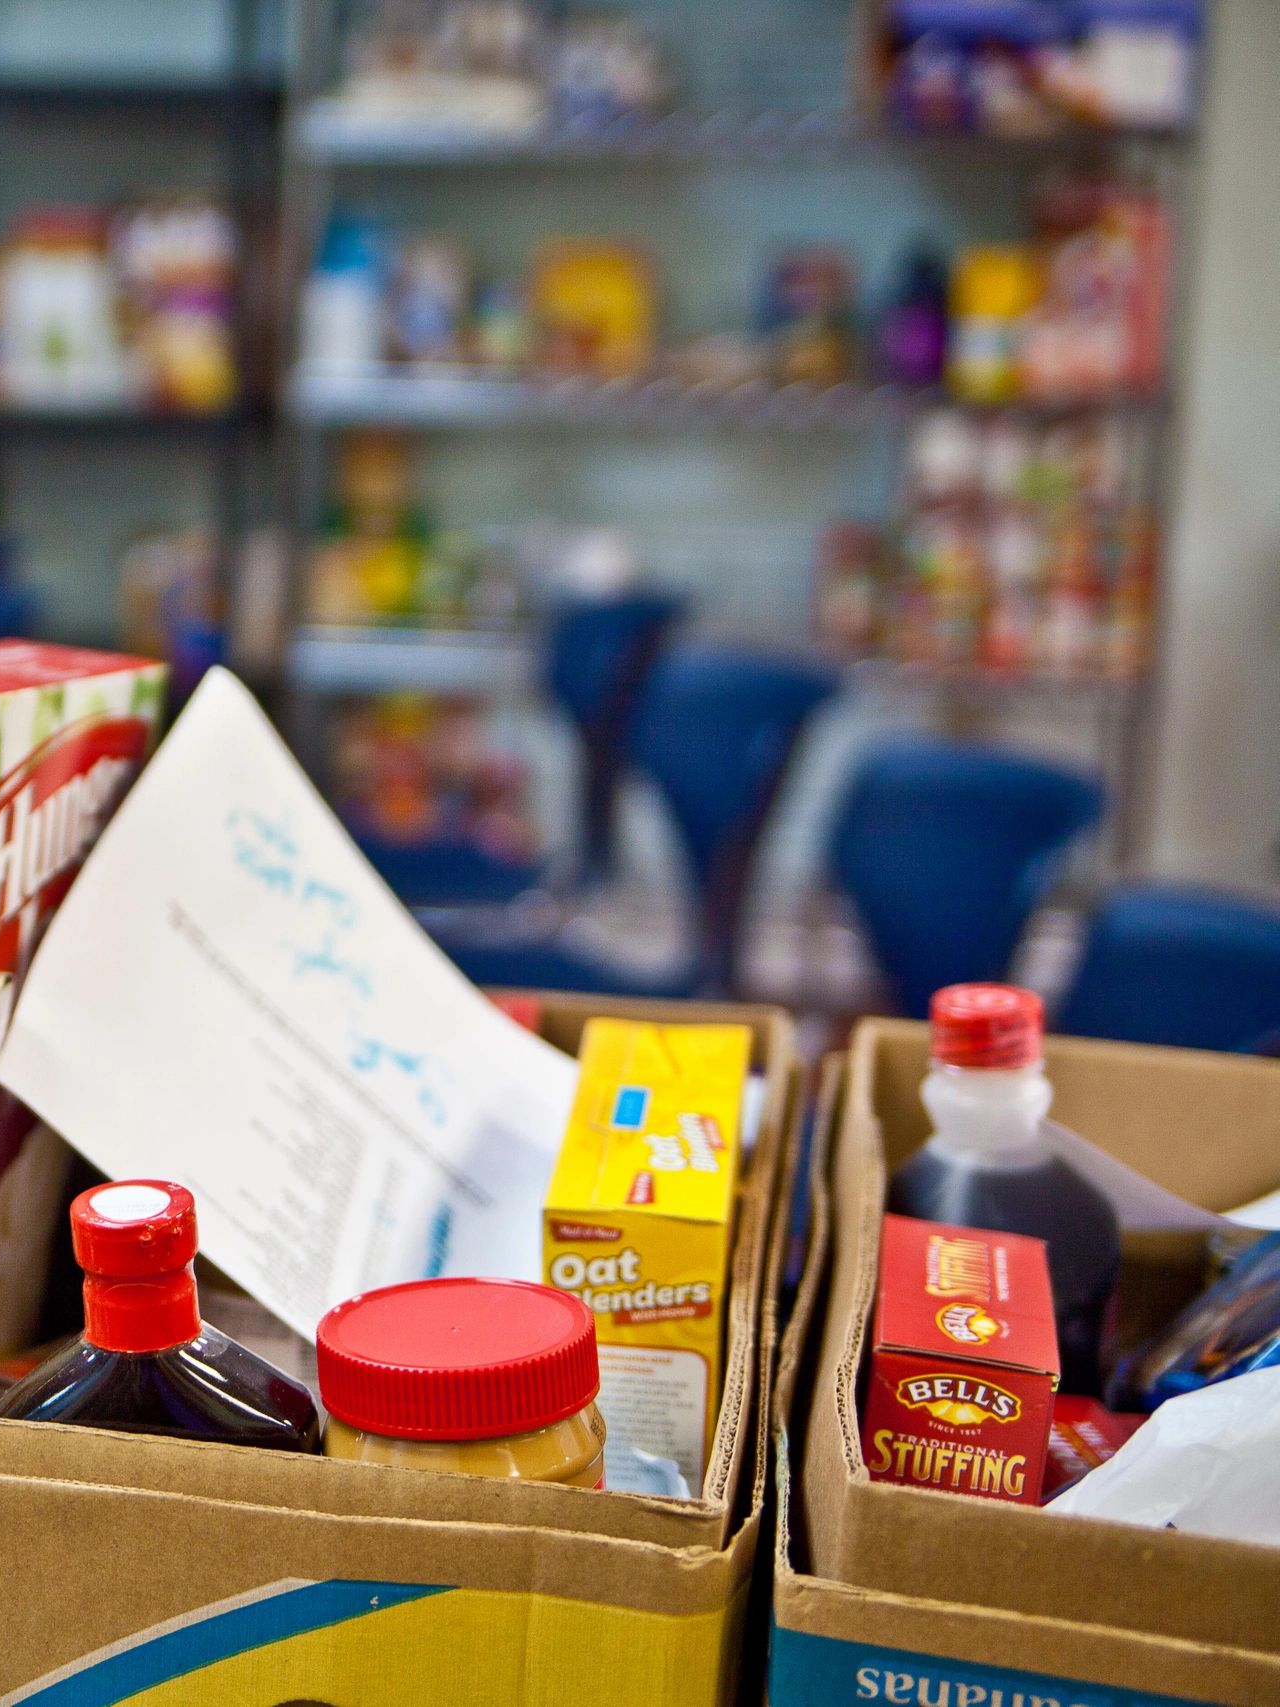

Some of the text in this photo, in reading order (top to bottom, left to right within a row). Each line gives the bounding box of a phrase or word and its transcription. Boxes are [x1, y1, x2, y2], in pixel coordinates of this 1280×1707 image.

[551, 1247, 640, 1290] Oat
[574, 1281, 711, 1313] lenders
[907, 1378, 1014, 1417] BELL'S
[928, 1420, 956, 1435] SINCE
[870, 1429, 1026, 1496] STUFFING
[897, 1433, 1008, 1460] TRADITIONAL
